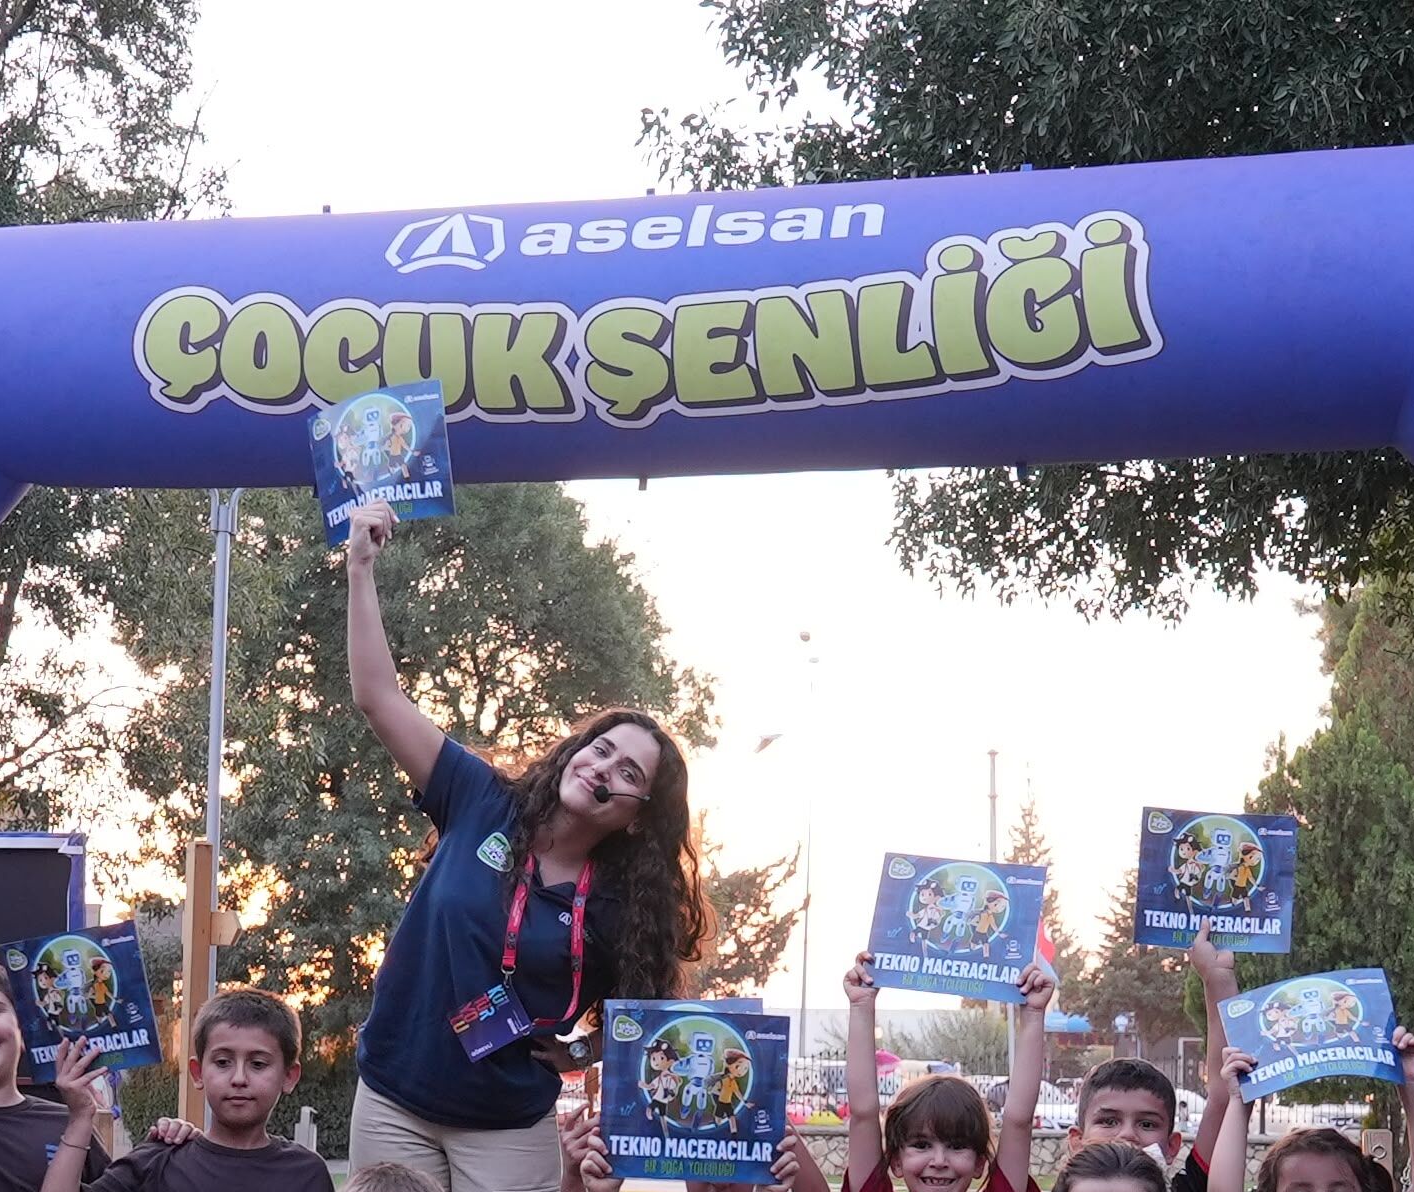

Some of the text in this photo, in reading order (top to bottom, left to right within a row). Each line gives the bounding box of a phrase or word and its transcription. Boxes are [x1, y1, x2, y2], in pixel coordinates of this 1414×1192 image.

[520, 202, 885, 259] aselsan
[137, 214, 1157, 423] ÇOCUK ŞENLİĞİ
[1144, 909, 1282, 935] TEKNO MCERACILAR
[874, 952, 1020, 985] TEKNO MACERACILAR
[1248, 1046, 1396, 1085] TEKNO MACERACILAR
[609, 1135, 773, 1162] TEKNO MACERACILAR
